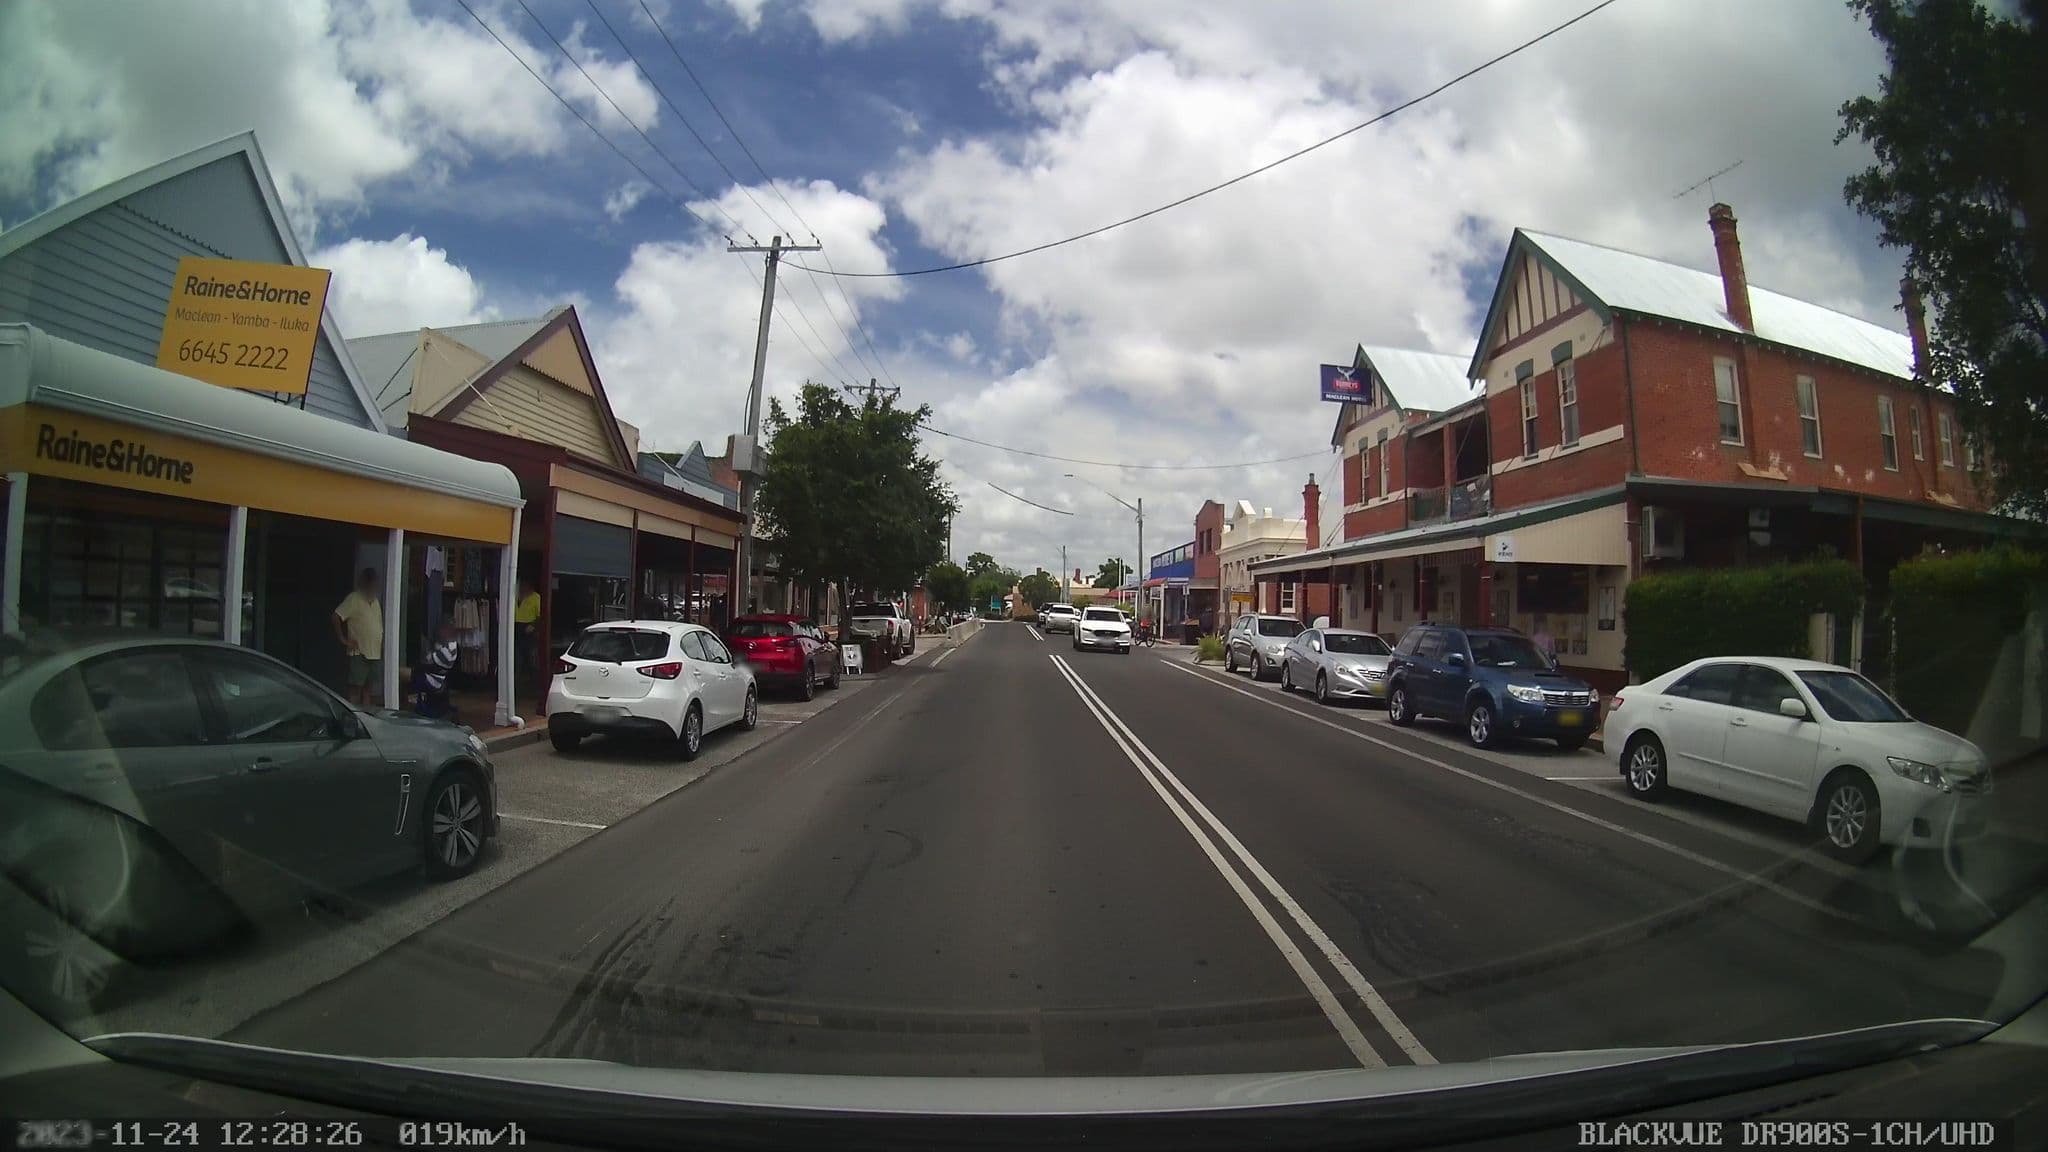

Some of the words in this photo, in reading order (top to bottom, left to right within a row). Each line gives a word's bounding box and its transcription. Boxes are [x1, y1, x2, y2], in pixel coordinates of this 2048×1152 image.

[184, 275, 311, 305] Raine&Horne
[175, 307, 221, 324] Maclean
[232, 312, 270, 329] Yamba
[280, 317, 310, 332] Iluka
[179, 339, 231, 365] 6645
[234, 344, 289, 371] 2222
[36, 423, 194, 484] Raine&Horne
